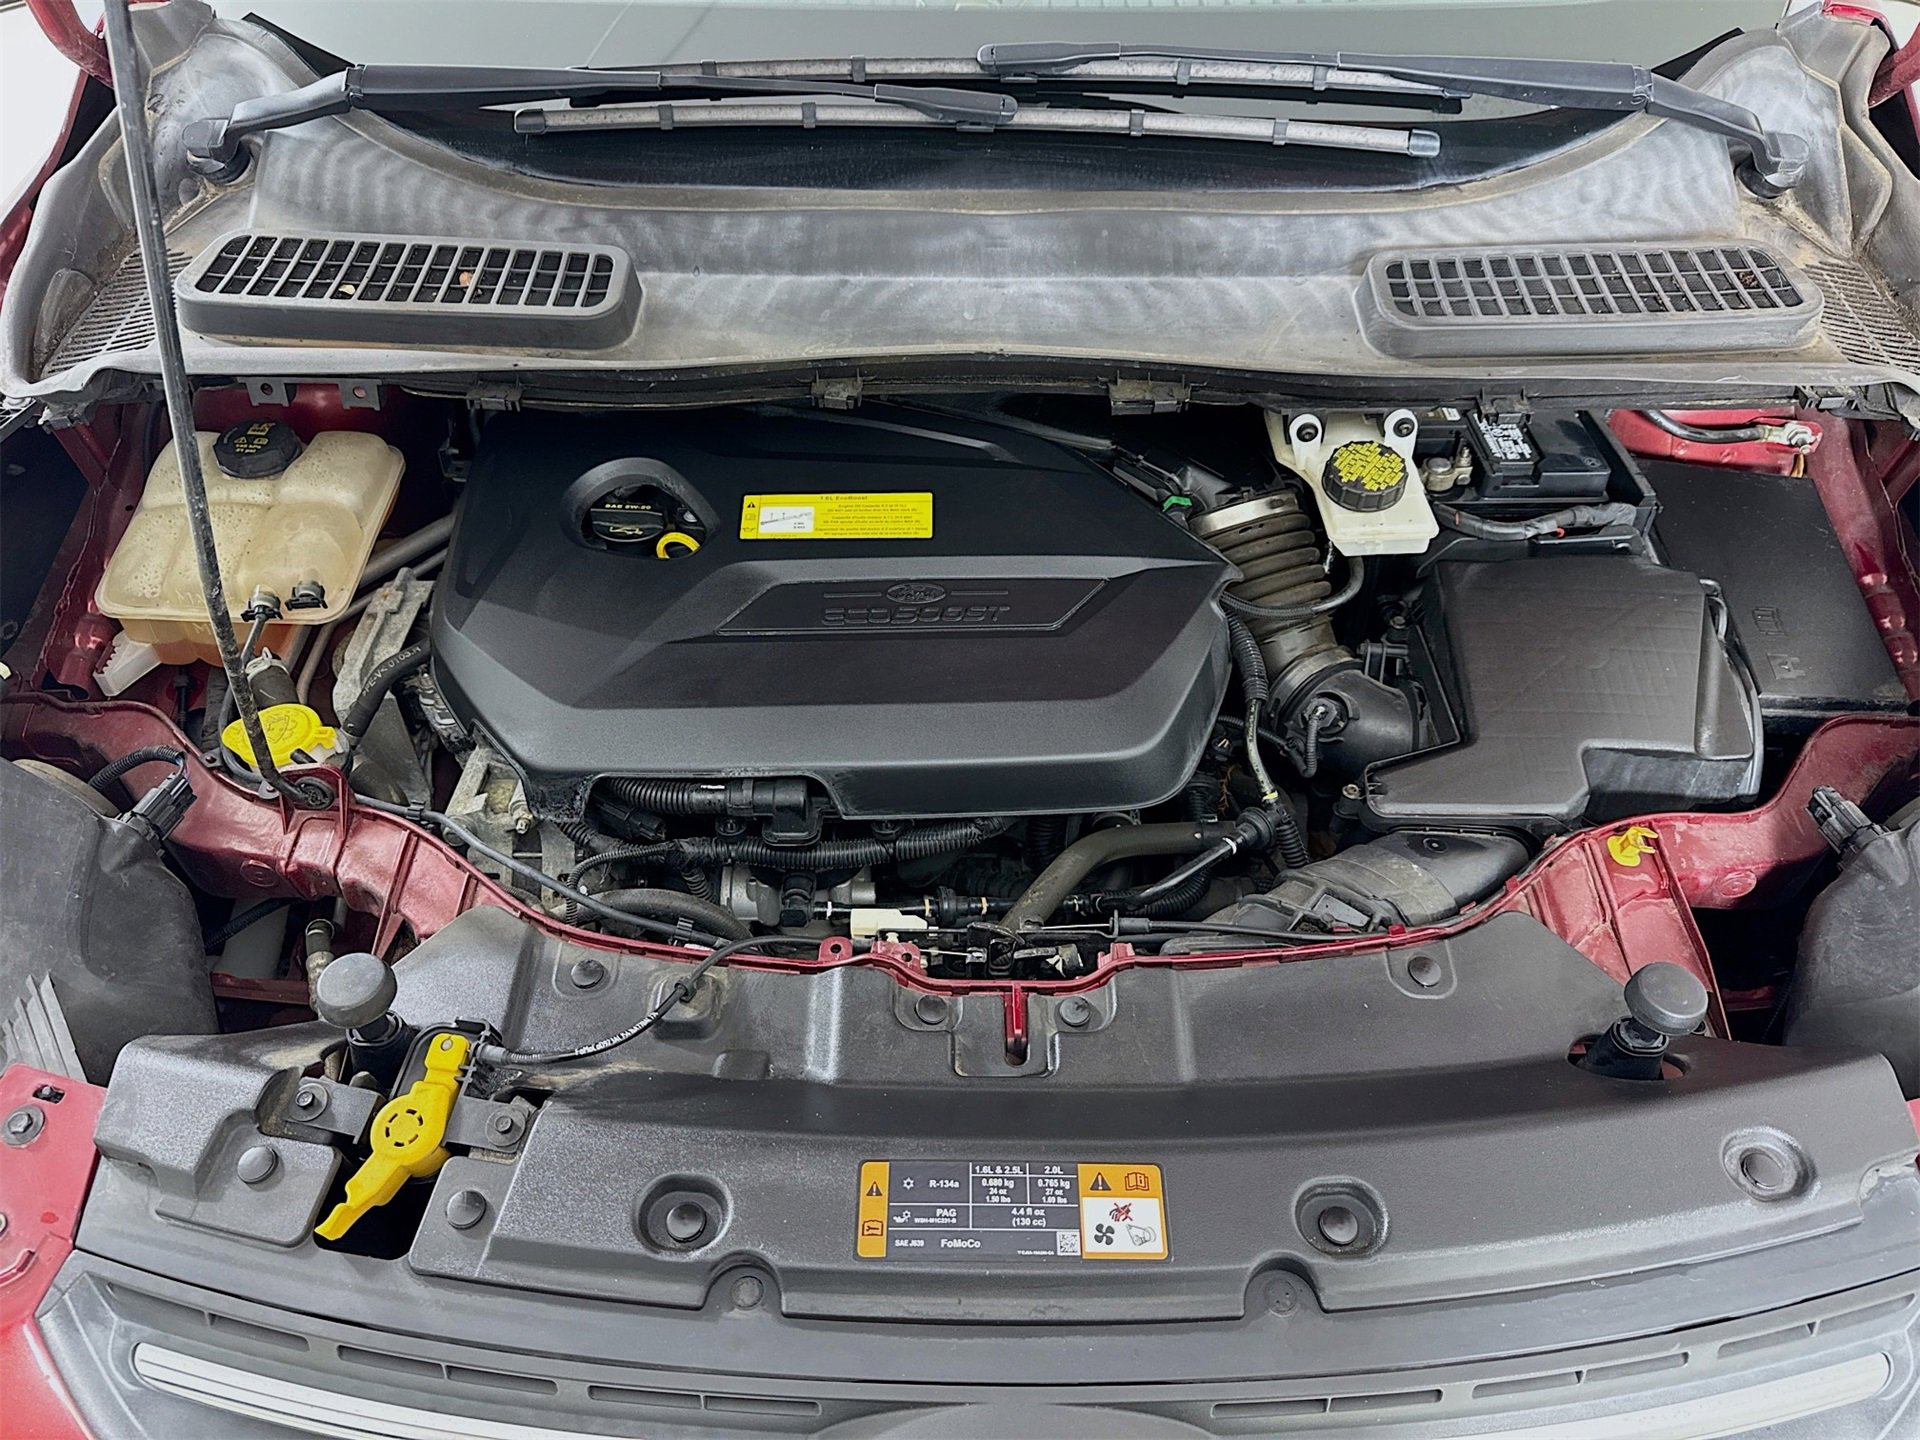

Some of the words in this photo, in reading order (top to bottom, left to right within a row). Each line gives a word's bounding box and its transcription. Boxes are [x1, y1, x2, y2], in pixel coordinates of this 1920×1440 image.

[974, 1165, 994, 1174] 1.6L
[995, 1165, 1003, 1174] &
[1004, 1165, 1024, 1175] 2.5L
[1044, 1165, 1064, 1175] 2.0L
[929, 1179, 960, 1189] R-134a
[1003, 1178, 1015, 1189] kg
[1059, 1179, 1071, 1190] kg
[988, 1187, 998, 1195] 24
[1045, 1188, 1054, 1196] 27
[999, 1195, 1012, 1203] lbs
[1056, 1196, 1068, 1205] lbs
[935, 1208, 957, 1217] PAG
[1010, 1207, 1025, 1216] 4.4
[1025, 1207, 1033, 1216] fl
[1033, 1209, 1046, 1217] oz
[1011, 1217, 1031, 1228] (130
[1031, 1217, 1047, 1228] cc)
[894, 1239, 908, 1247] SAE
[939, 1238, 981, 1249] FoMoCo
